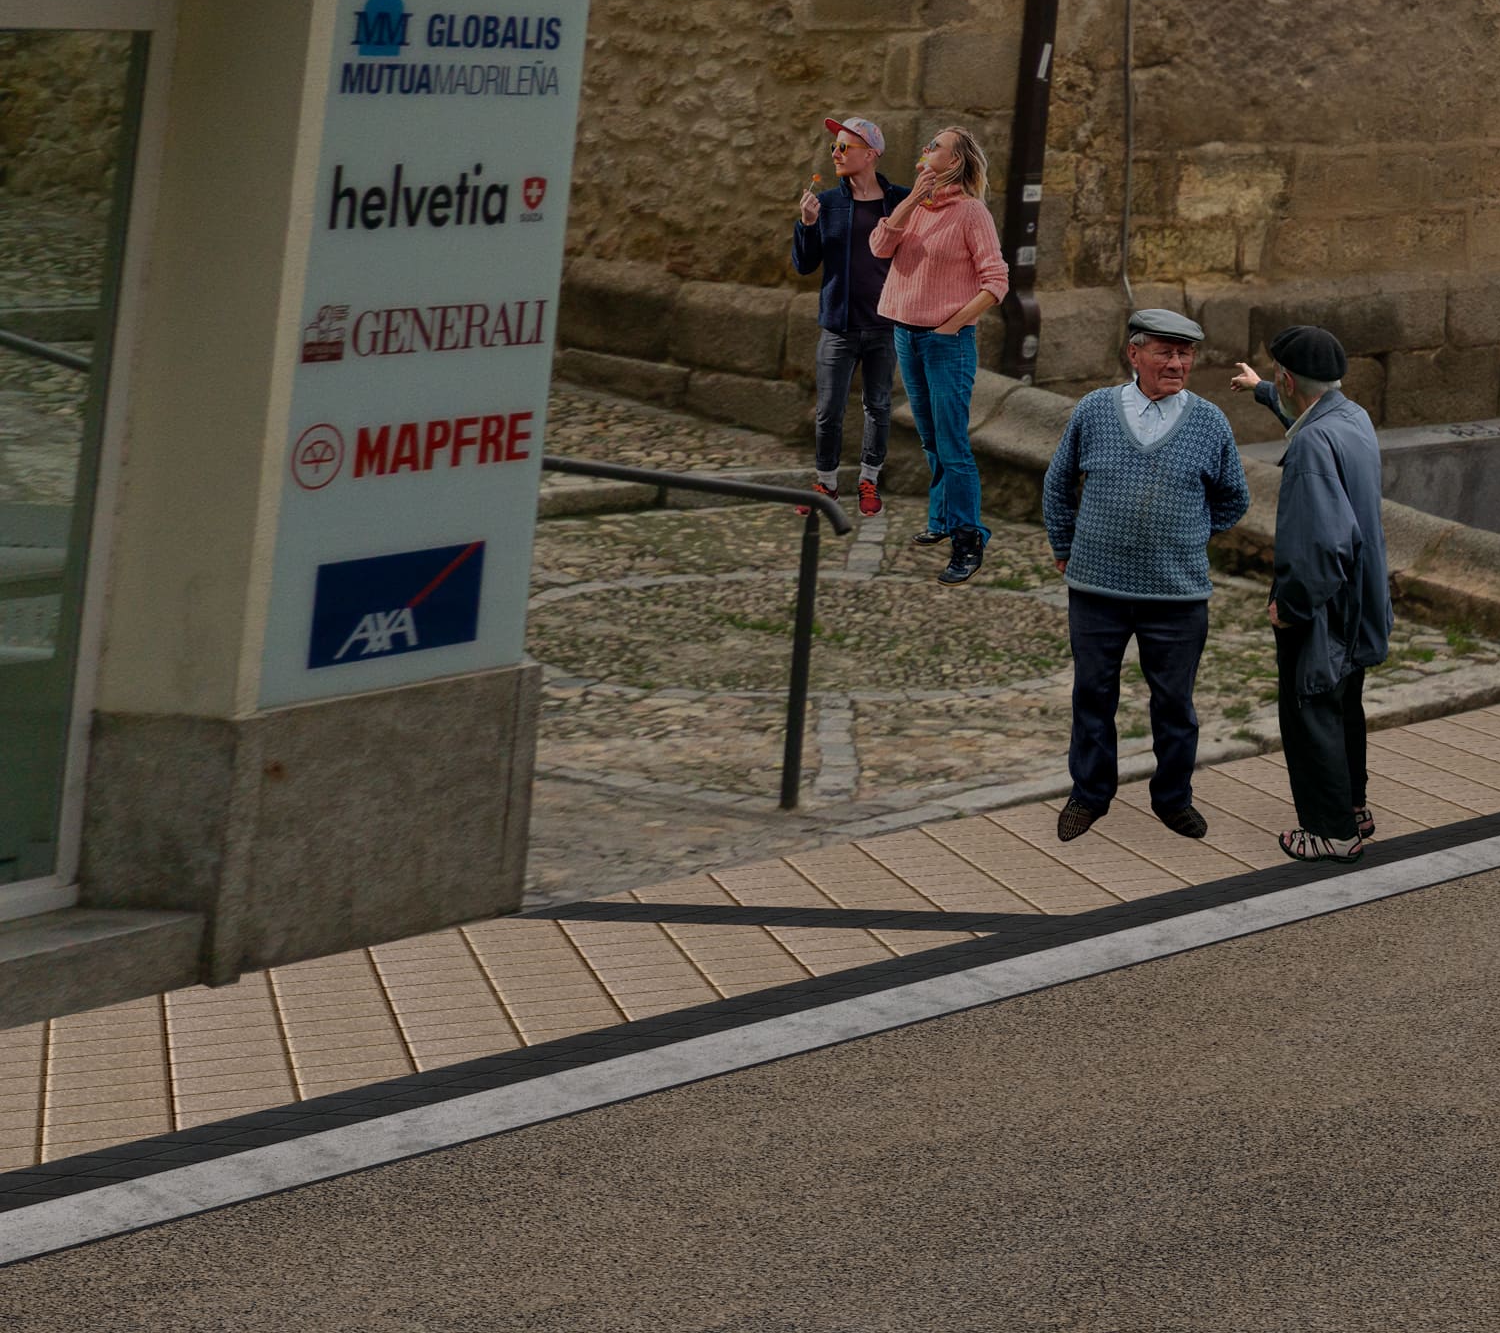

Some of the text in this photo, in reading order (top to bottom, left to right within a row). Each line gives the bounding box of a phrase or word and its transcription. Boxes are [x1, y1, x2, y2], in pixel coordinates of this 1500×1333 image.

[426, 14, 562, 51] GLOBALIS
[328, 164, 508, 231] helvetia
[352, 299, 549, 358] GENERALI
[352, 411, 534, 479] MAPFRE
[333, 606, 419, 660] AXA
